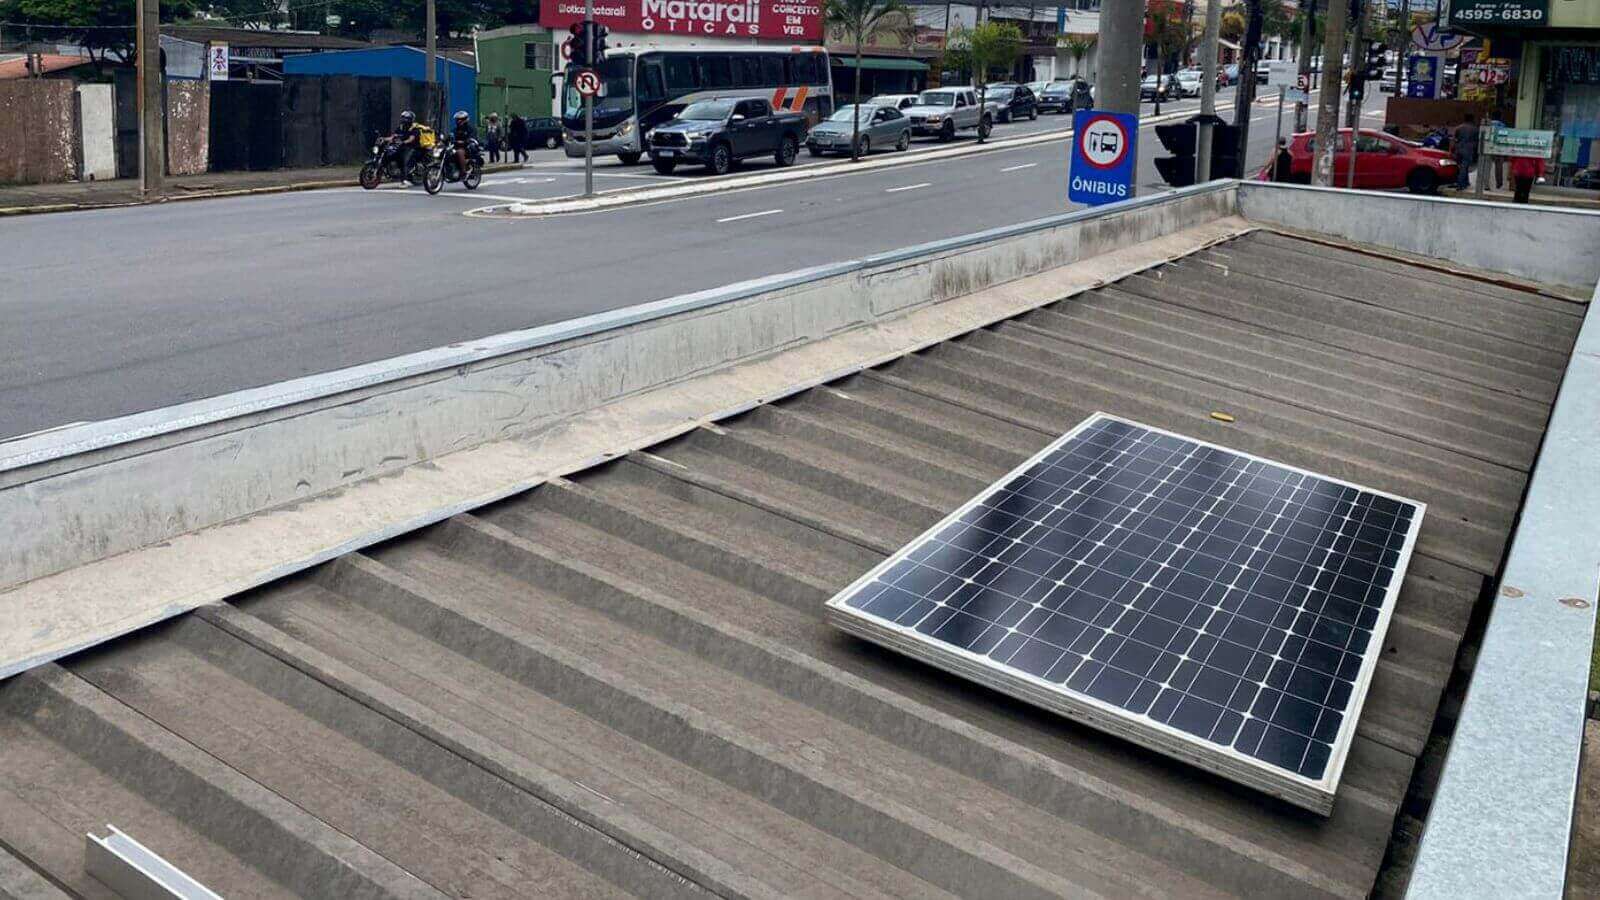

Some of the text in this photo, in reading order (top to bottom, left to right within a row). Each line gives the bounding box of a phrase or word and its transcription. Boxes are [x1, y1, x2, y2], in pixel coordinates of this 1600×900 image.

[641, 0, 760, 23] Matarali
[772, 4, 820, 15] CONCEITO
[1455, 9, 1543, 20] 4595-6830
[786, 15, 802, 25] EM
[782, 25, 804, 35] VER
[1072, 176, 1127, 197] ÔNIBUS
